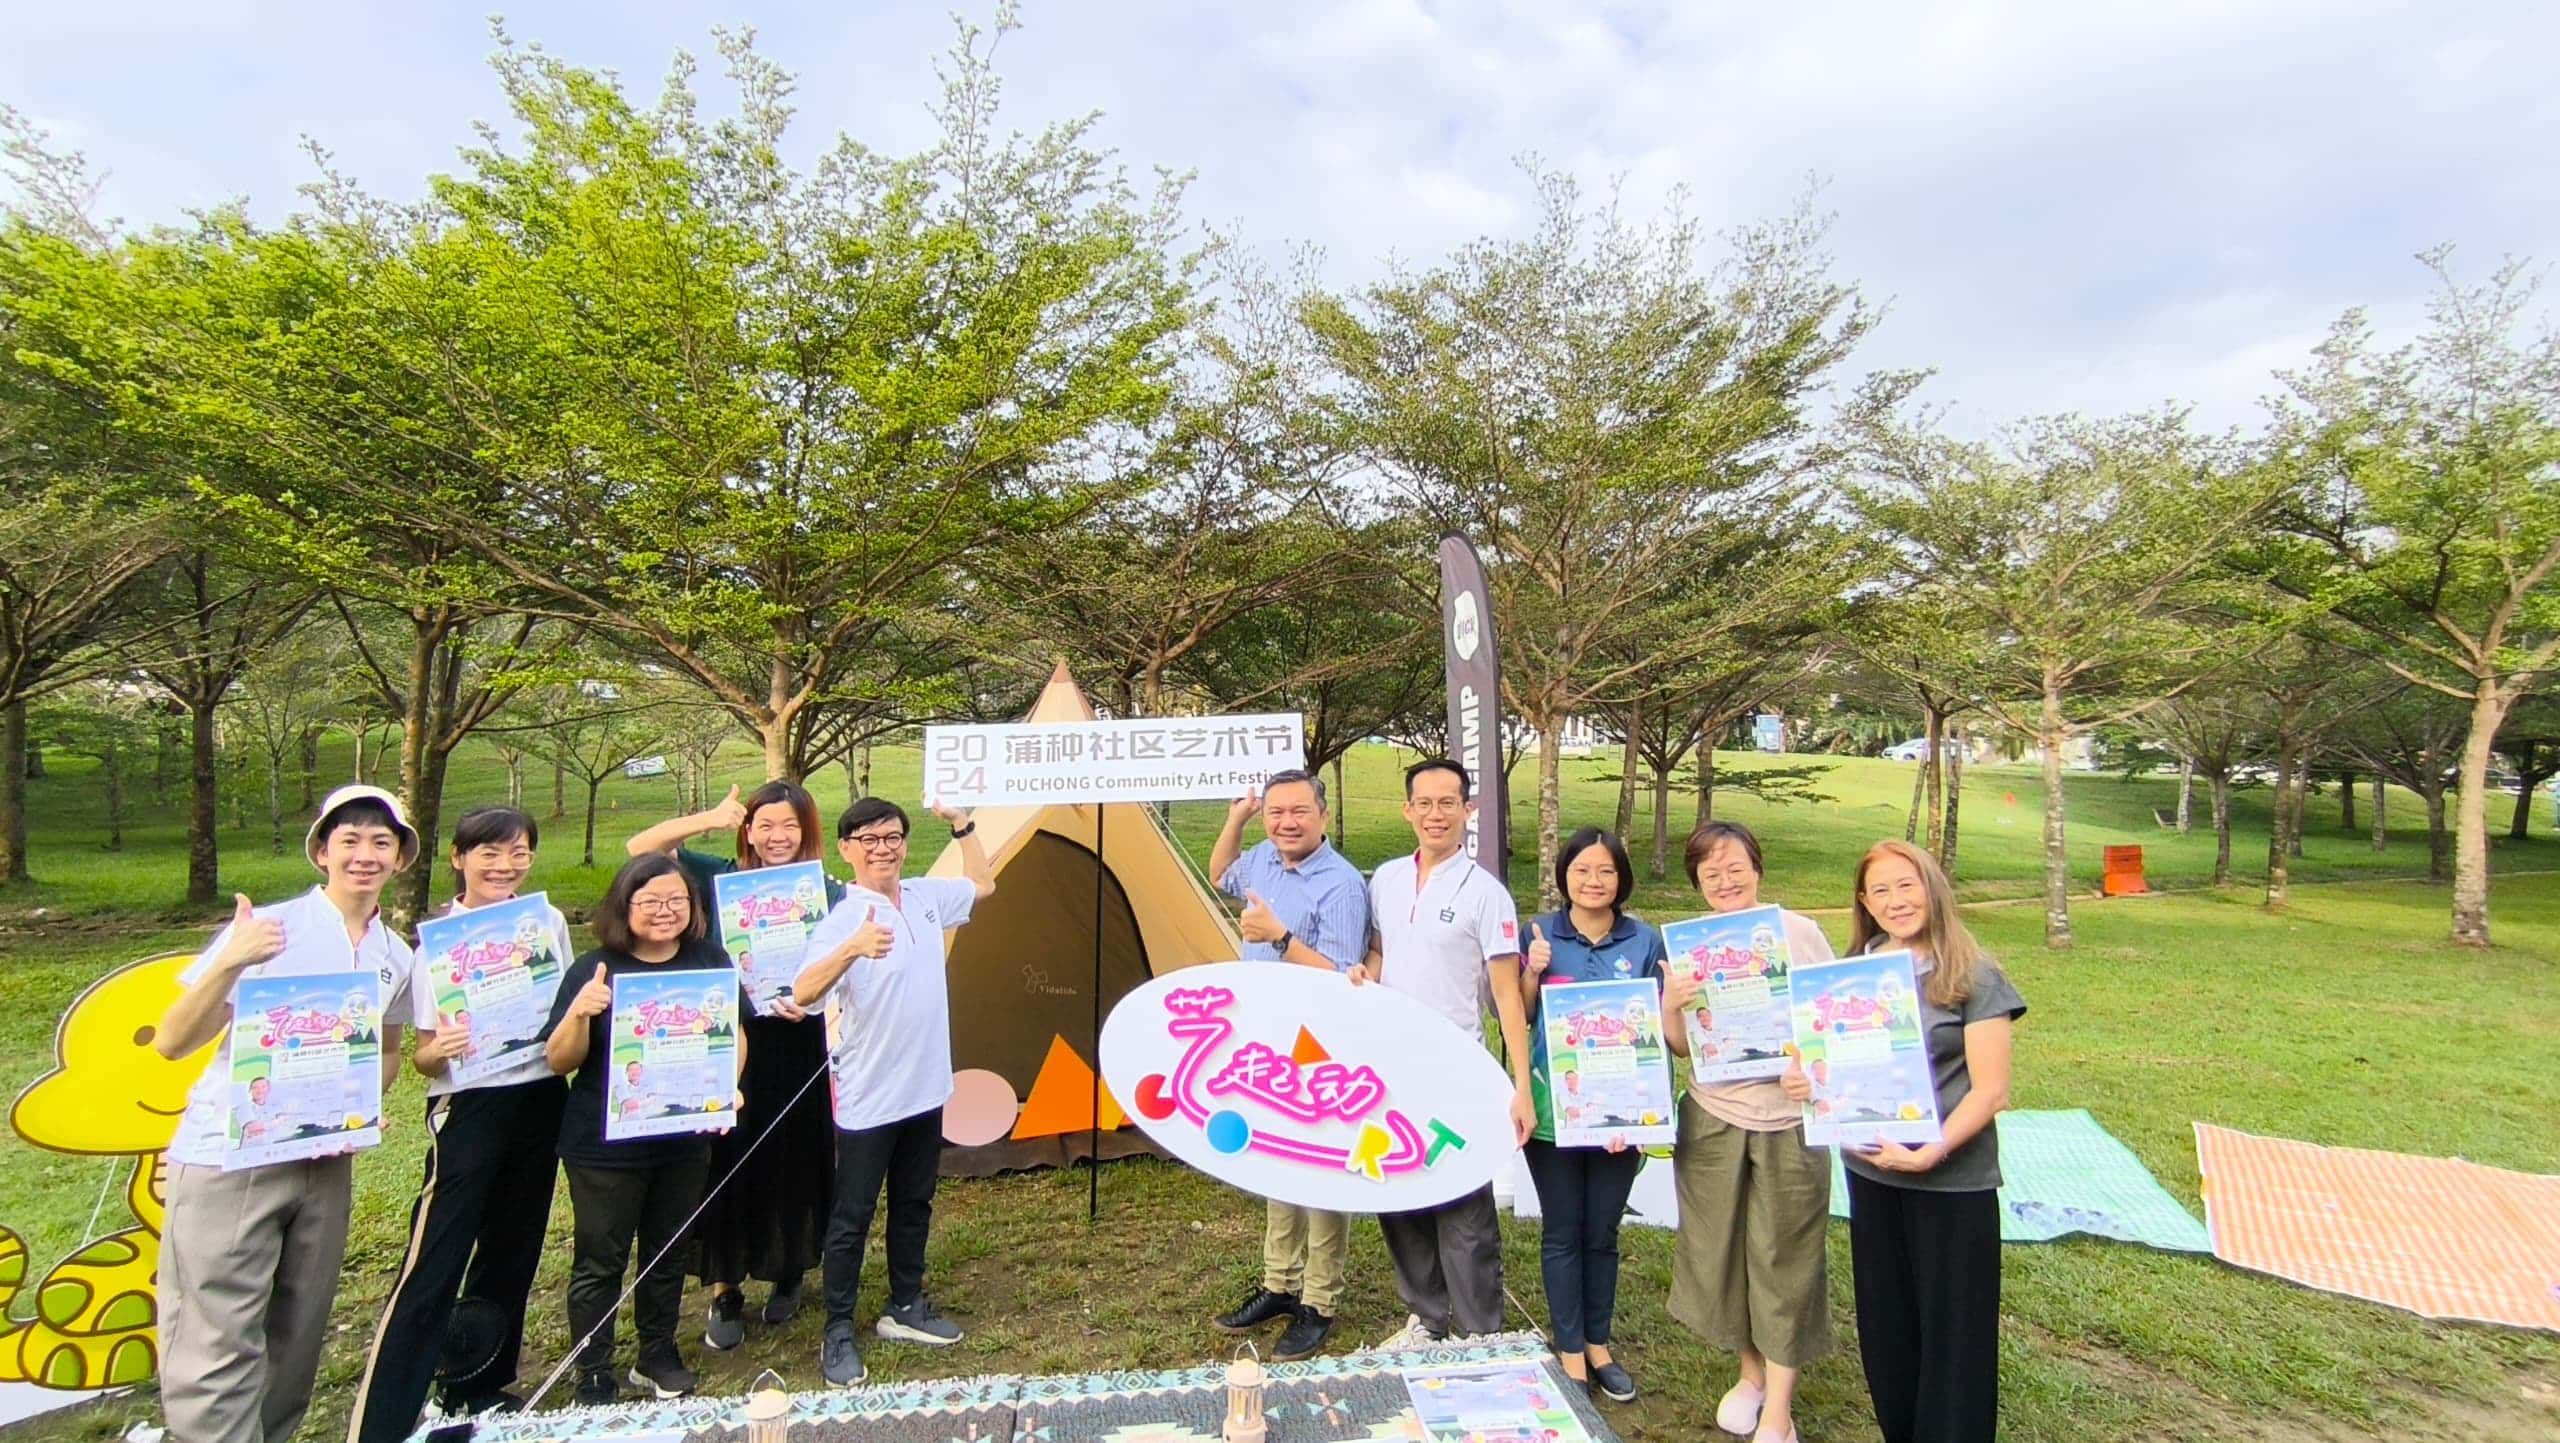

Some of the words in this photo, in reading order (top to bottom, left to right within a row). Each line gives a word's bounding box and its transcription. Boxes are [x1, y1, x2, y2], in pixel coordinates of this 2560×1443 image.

[936, 734, 987, 762] 20
[1004, 724, 1293, 765] 蒲种社区艺术节
[936, 766, 988, 795] 24
[1005, 776, 1090, 792] PUCHONG
[1095, 770, 1193, 790] Community
[1198, 769, 1223, 785] Art
[1164, 984, 1427, 1176] 艺起动
